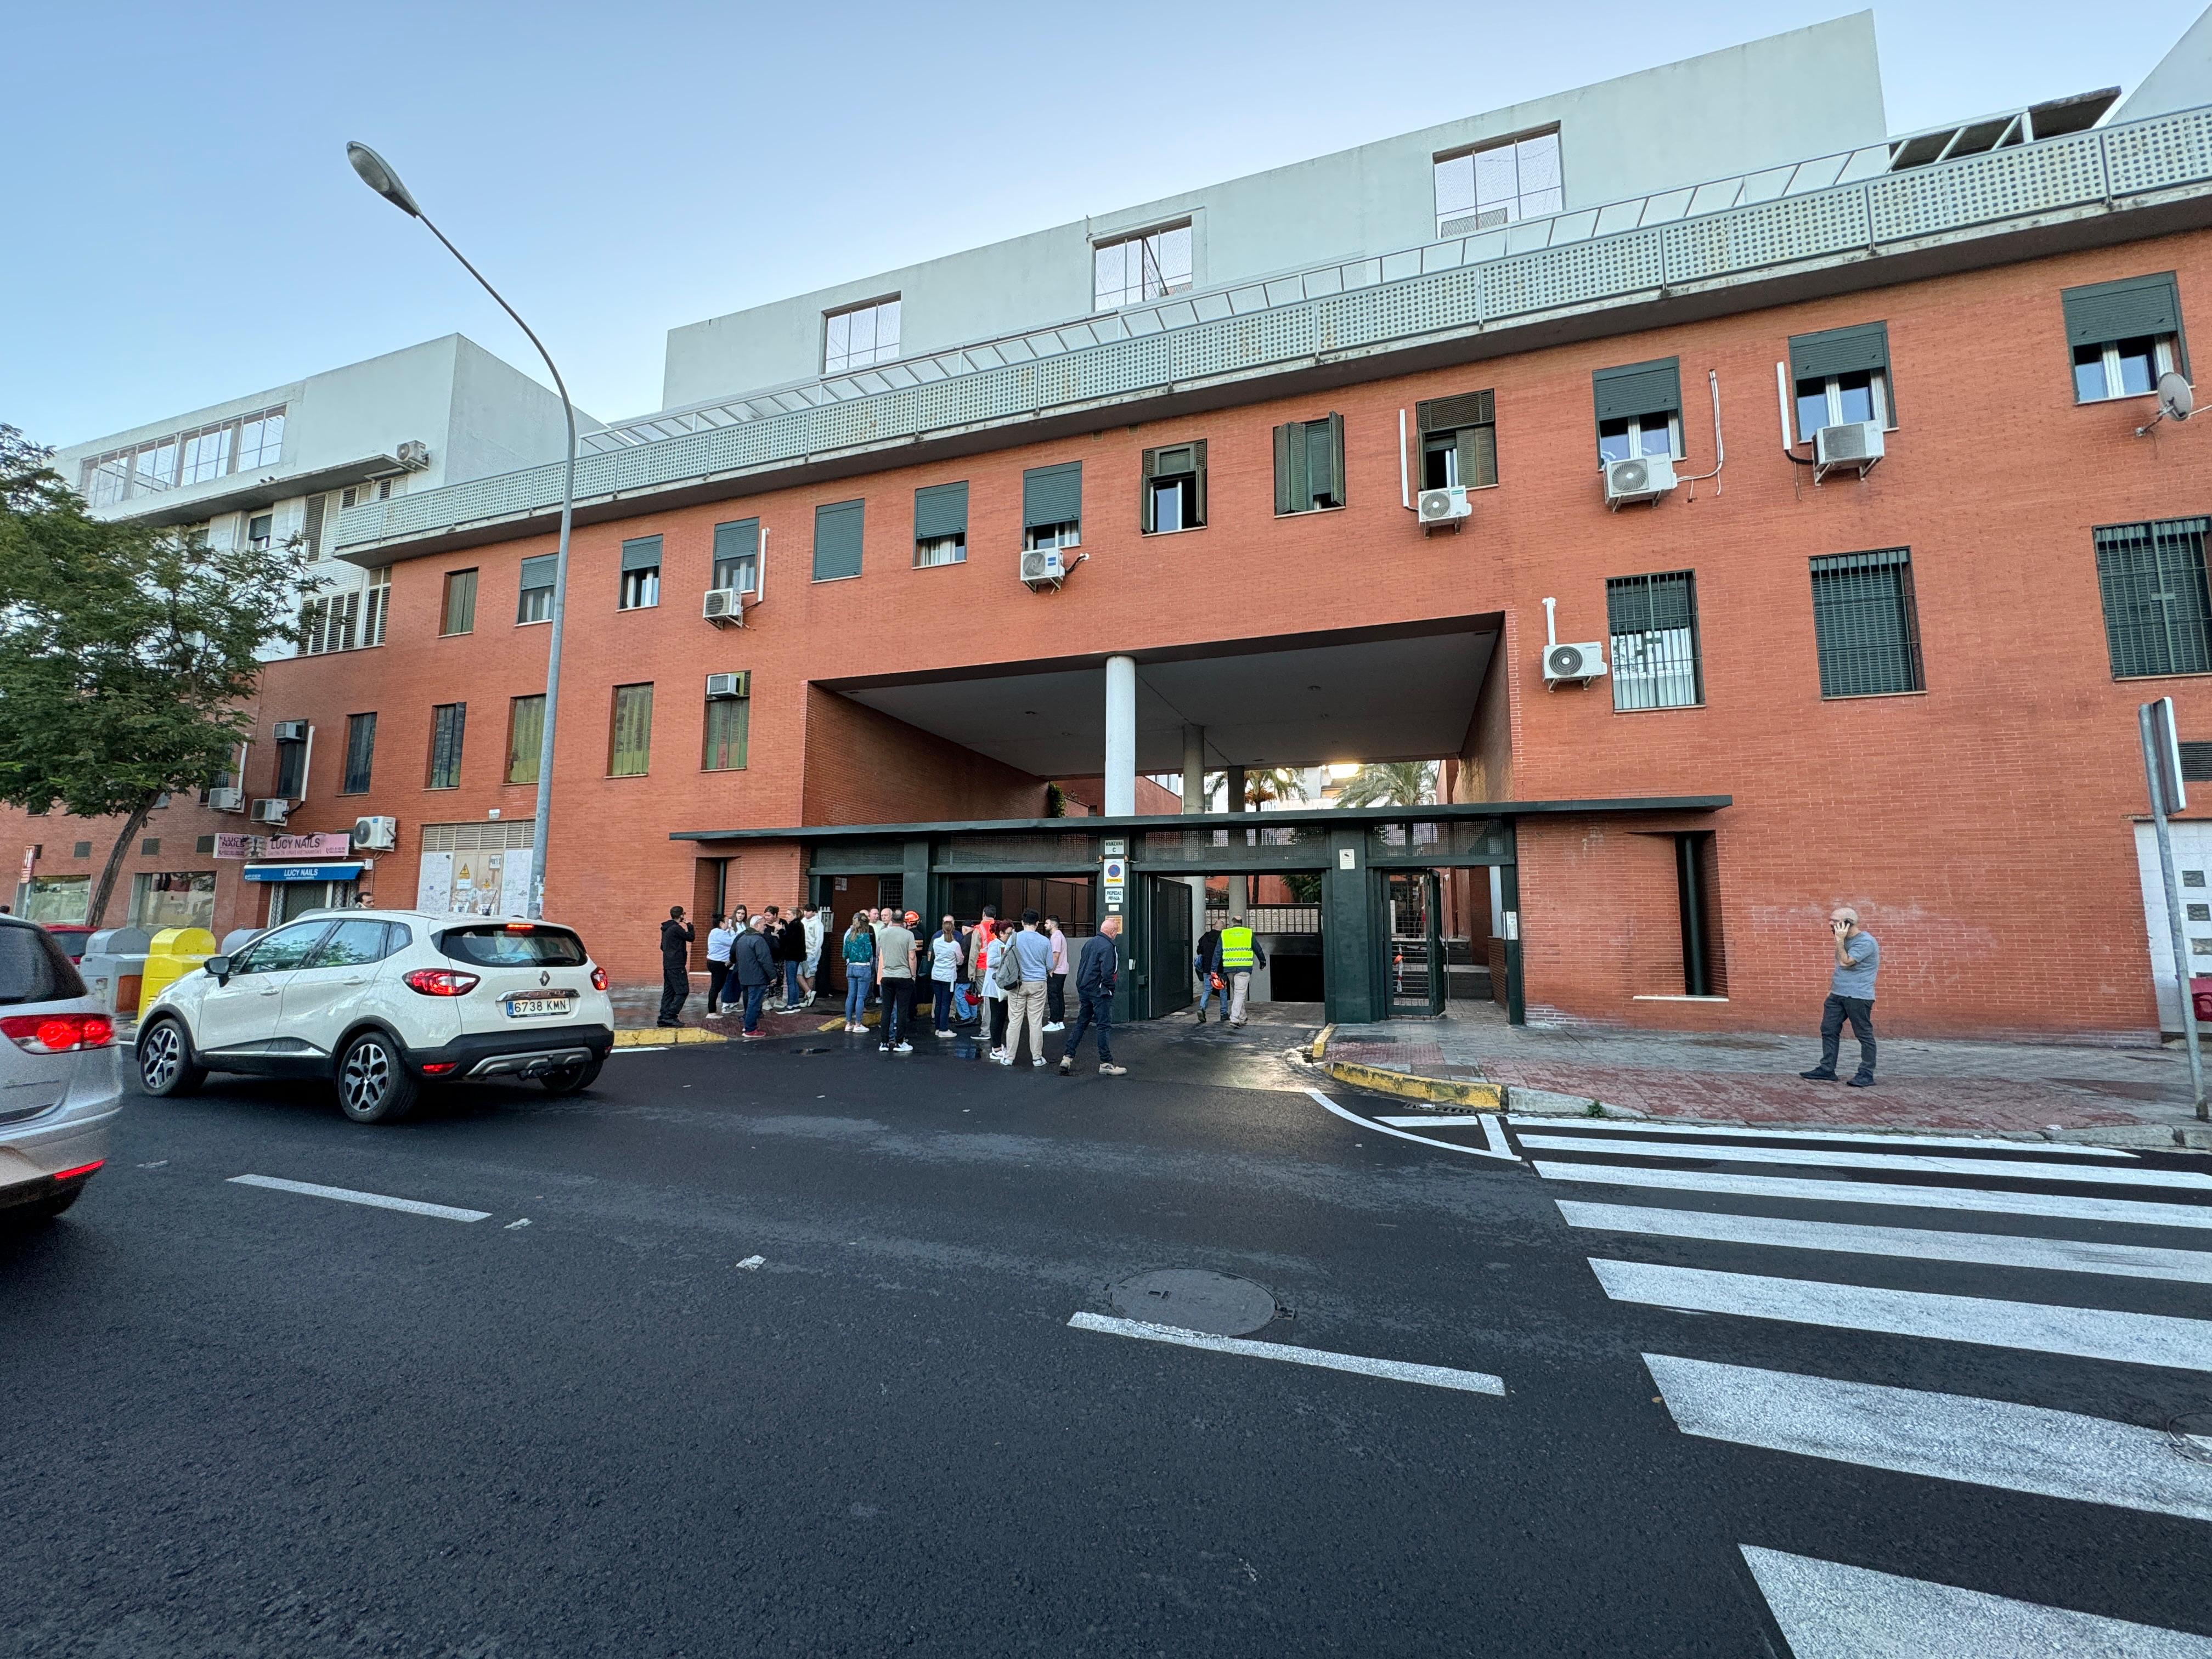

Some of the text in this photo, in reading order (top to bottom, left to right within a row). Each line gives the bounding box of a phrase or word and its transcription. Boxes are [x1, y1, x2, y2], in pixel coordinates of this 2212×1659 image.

[270, 838, 320, 849] LUCY NAILS
[515, 1001, 566, 1012] 6738 KMN
